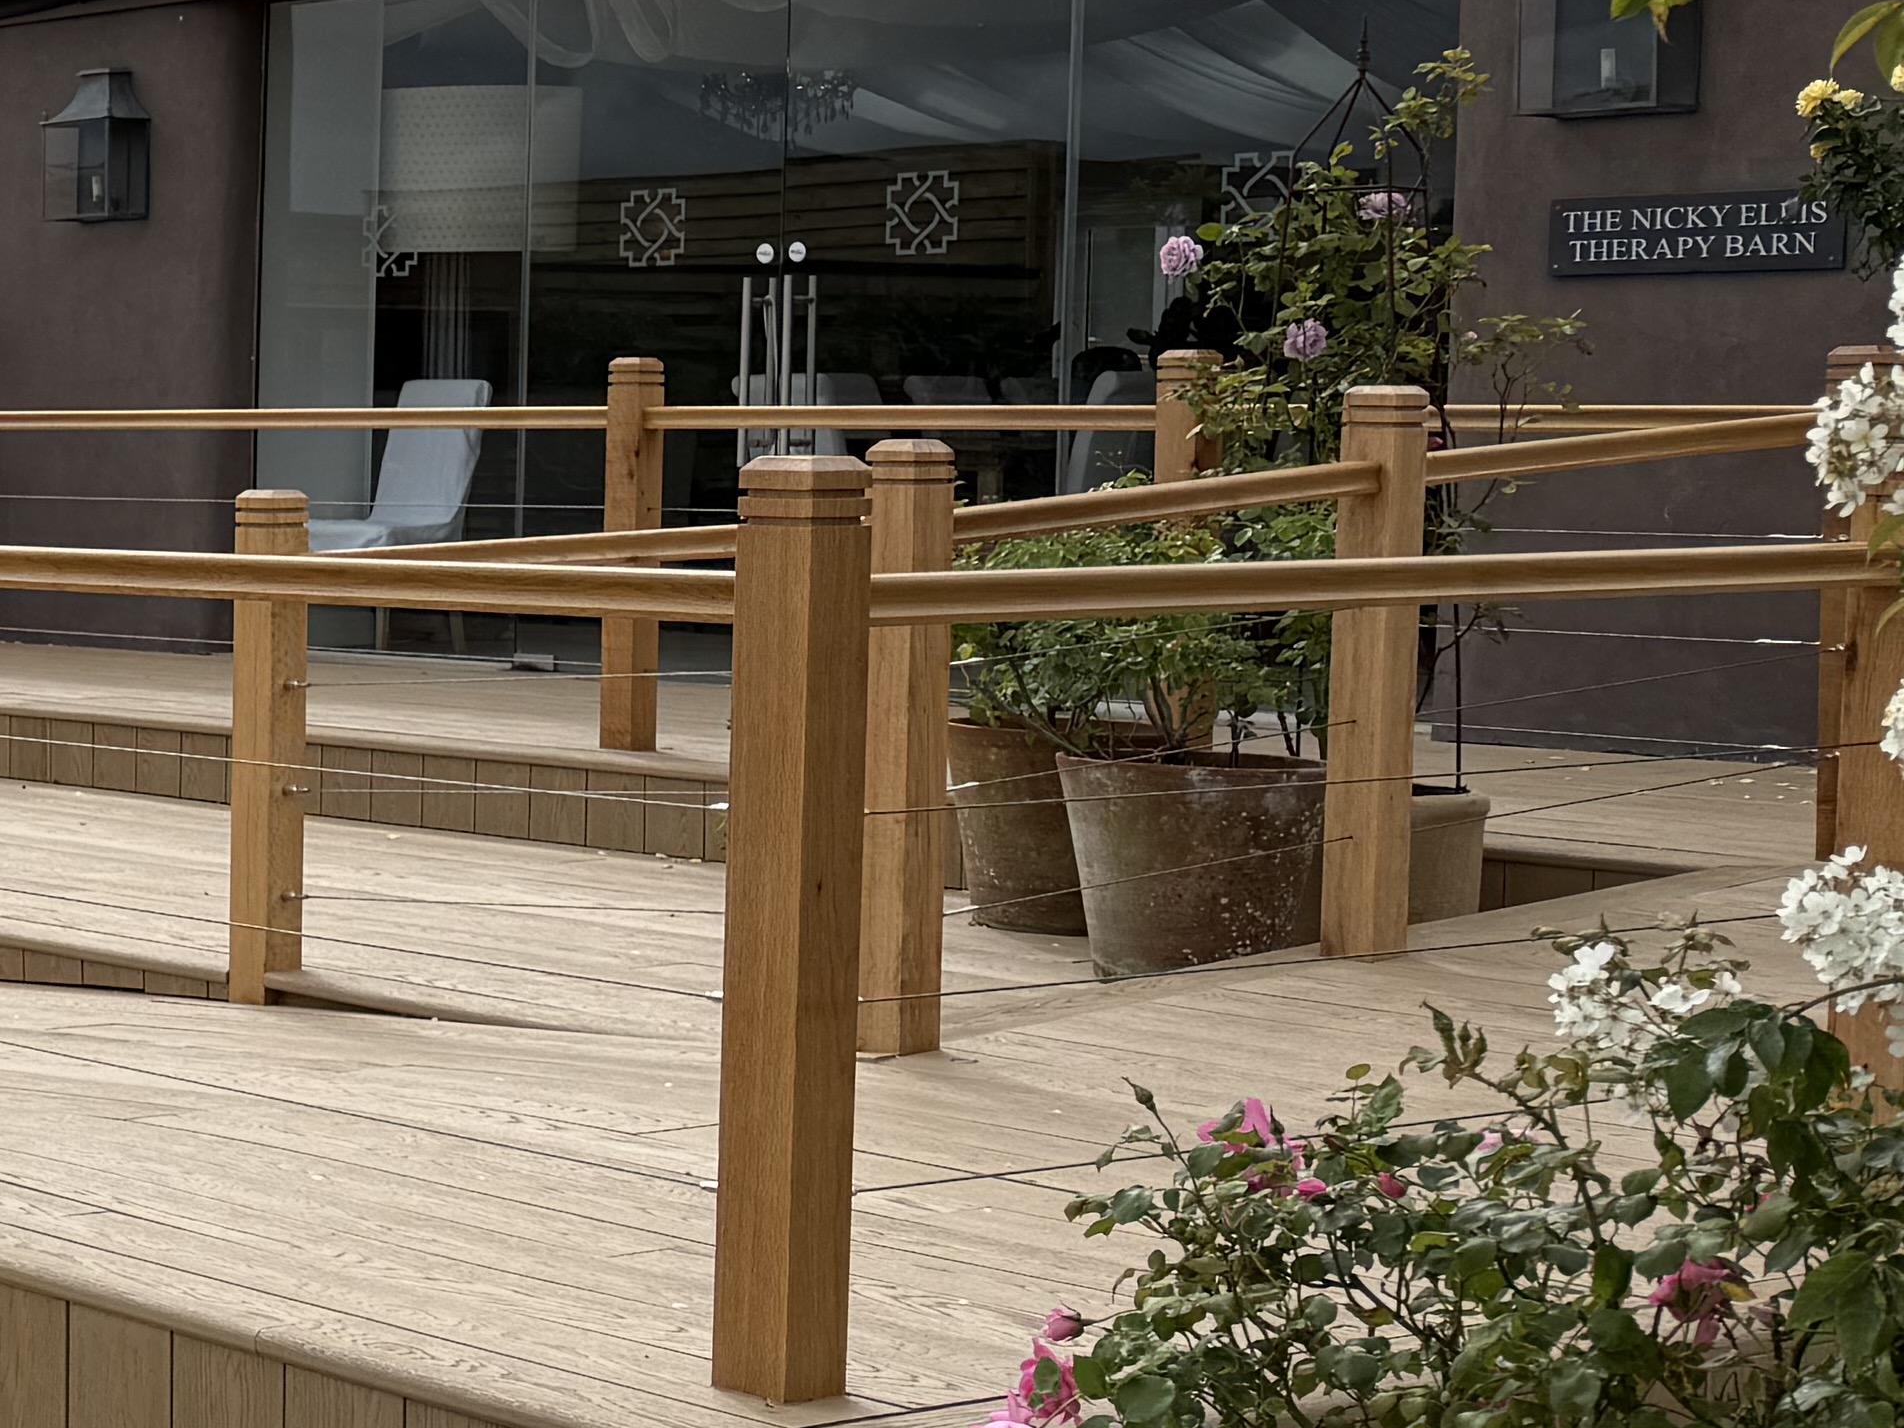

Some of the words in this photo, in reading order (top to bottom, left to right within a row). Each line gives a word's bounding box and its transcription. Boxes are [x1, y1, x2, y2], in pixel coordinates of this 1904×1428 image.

[1562, 209, 1623, 233] THE
[1630, 204, 1733, 231] NICKY
[1568, 235, 1716, 262] THERAPY
[1724, 231, 1816, 258] BARN
